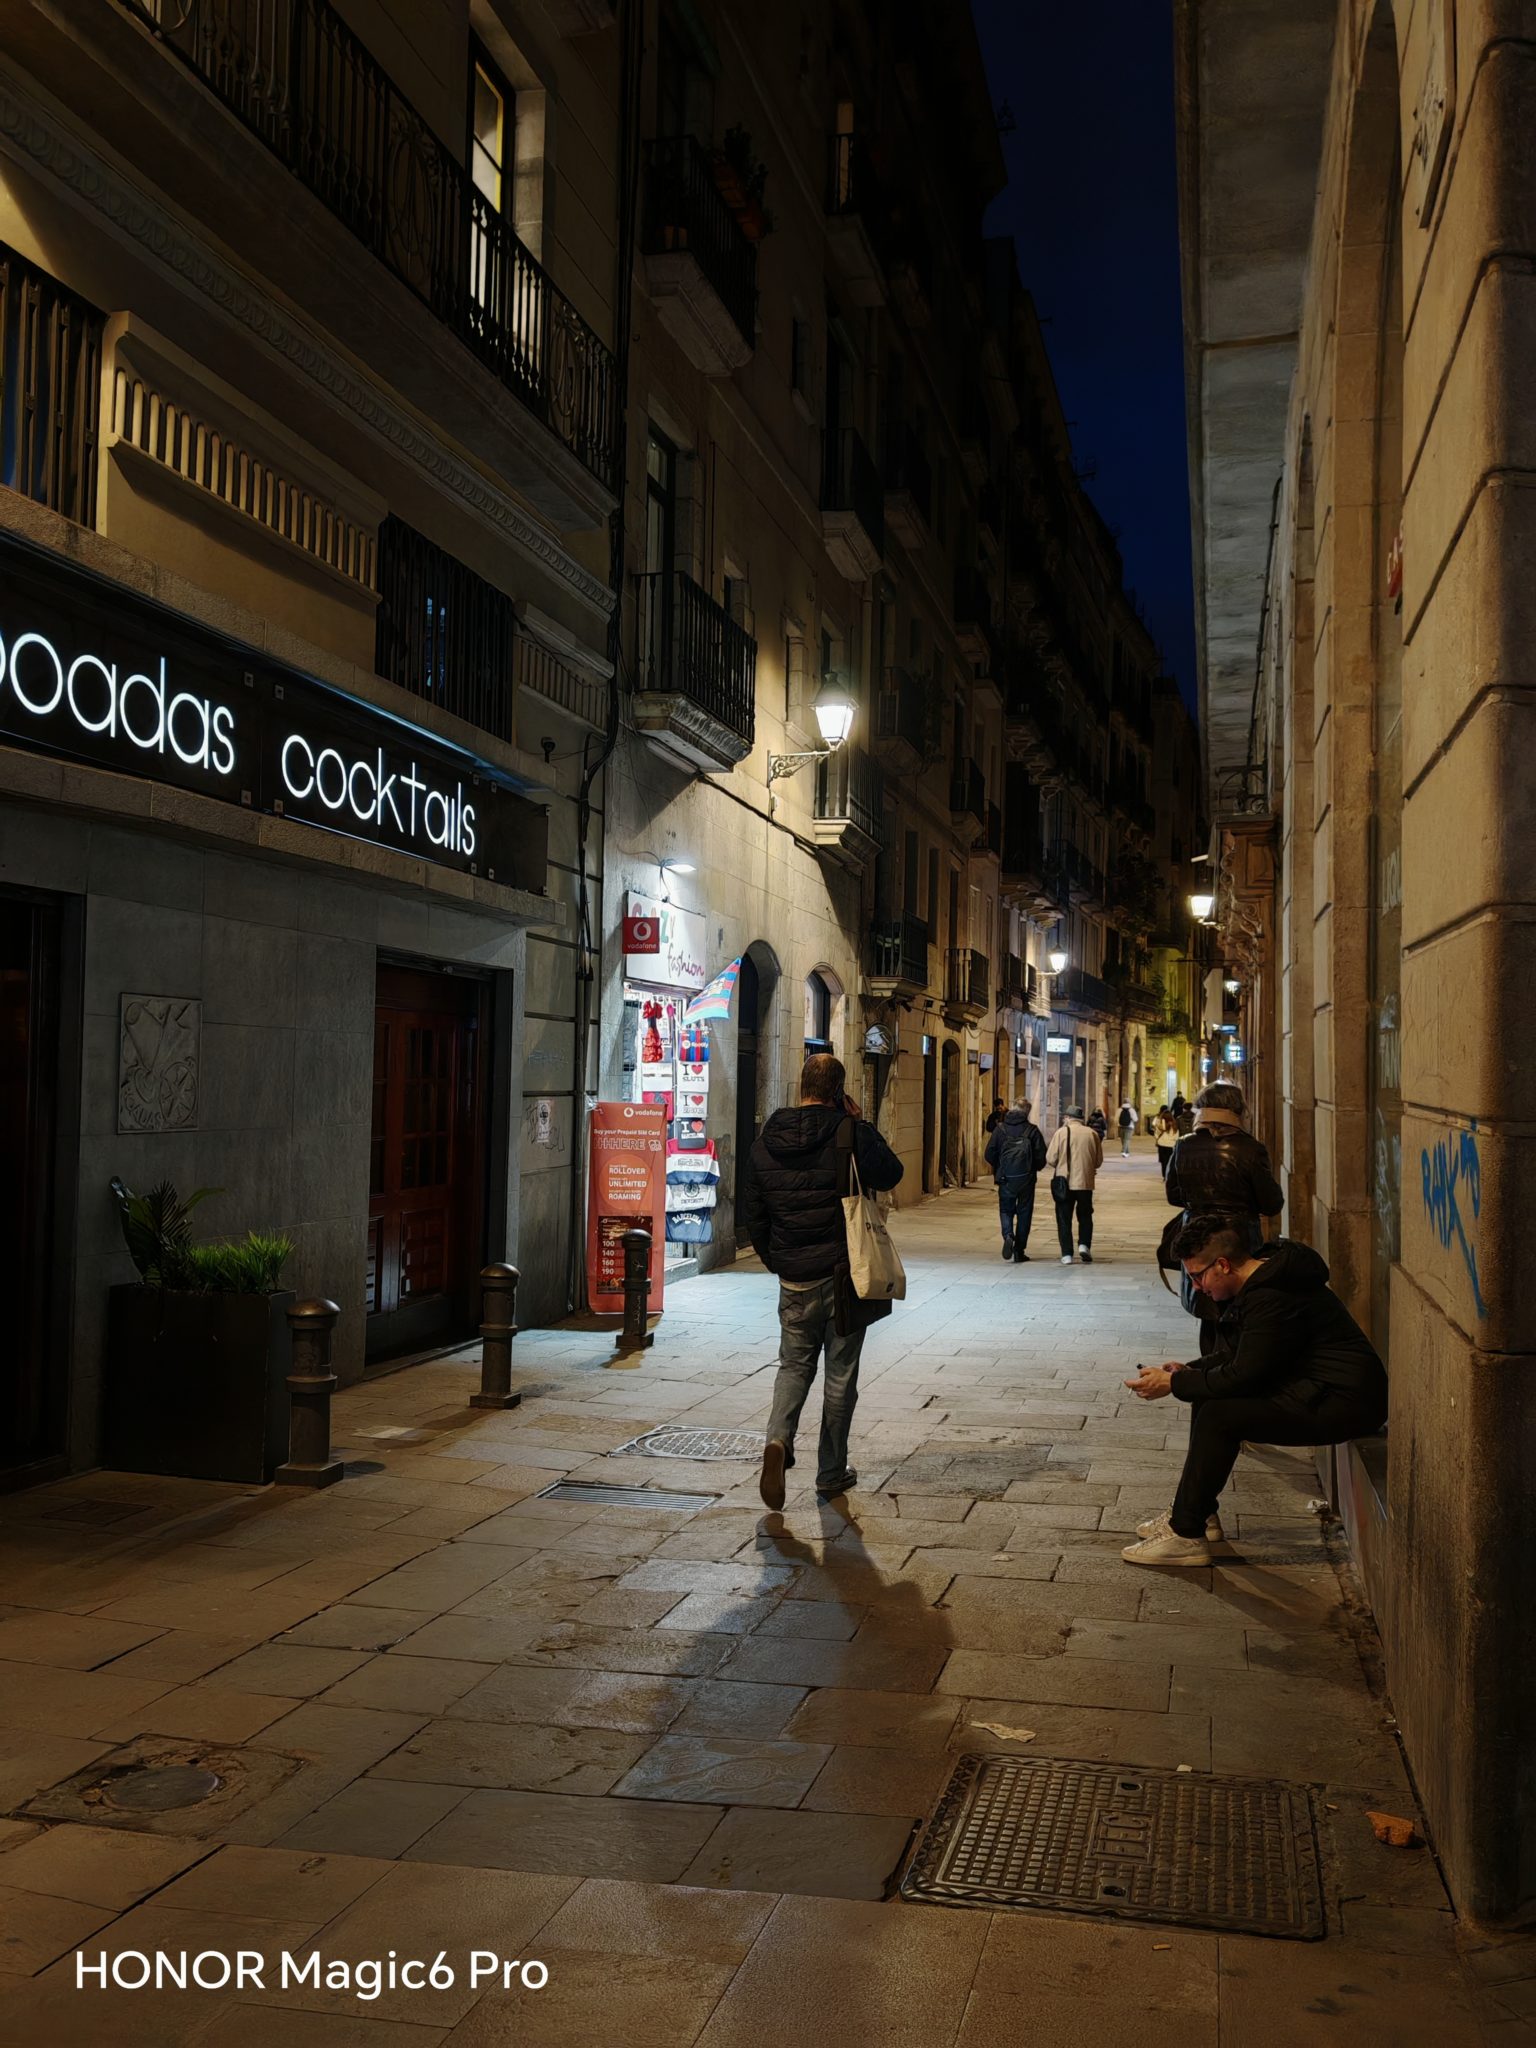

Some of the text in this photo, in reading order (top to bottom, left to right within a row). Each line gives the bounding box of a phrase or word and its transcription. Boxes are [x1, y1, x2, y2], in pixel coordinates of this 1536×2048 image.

[0, 629, 477, 856] oadas cocktails
[627, 942, 657, 950] vodafone
[668, 942, 705, 978] fashion
[635, 1109, 664, 1117] vodafone
[608, 1167, 646, 1175] ROLLOVER
[608, 1179, 648, 1188] UNLIMITED
[608, 1192, 642, 1200] ROAMING
[602, 1240, 615, 1248] 100
[602, 1249, 615, 1257] 140
